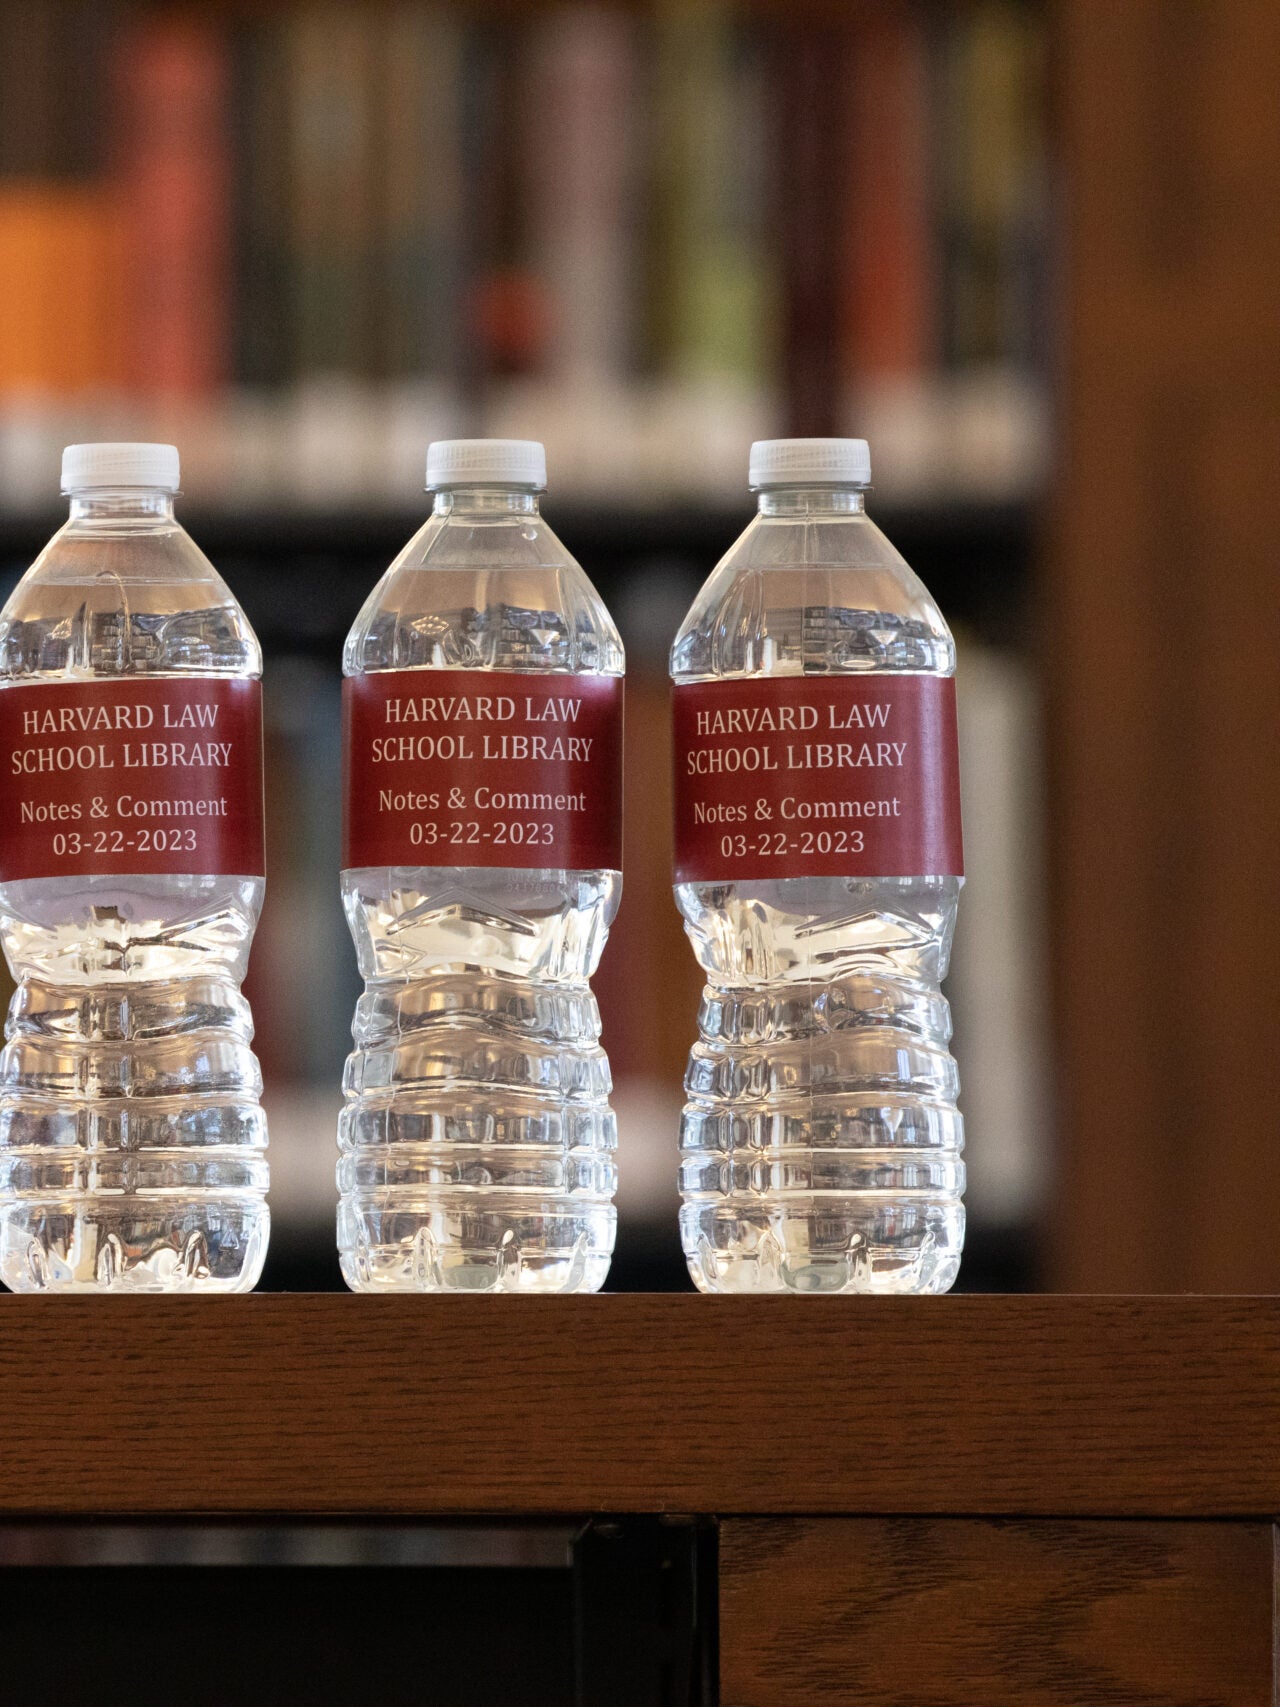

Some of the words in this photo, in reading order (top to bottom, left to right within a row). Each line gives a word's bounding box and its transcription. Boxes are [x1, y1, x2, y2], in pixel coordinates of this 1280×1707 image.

[23, 705, 153, 735] HARVARD
[163, 704, 219, 728] LAW
[385, 697, 515, 723] HARVARD
[525, 697, 581, 722] LAW
[697, 706, 818, 735] HARVARD
[828, 704, 891, 729] LAW
[12, 745, 114, 774] SCHOOL
[123, 743, 233, 767] LIBRARY
[372, 736, 473, 762] SCHOOL
[483, 736, 594, 762] LIBRARY
[687, 746, 778, 775] SCHOOL
[787, 743, 907, 769] LIBRARY
[21, 801, 82, 823] Notes
[90, 797, 109, 818] &
[117, 796, 227, 818] Comment
[379, 789, 439, 811] Notes
[447, 787, 467, 809] &
[475, 787, 586, 812] Comment
[694, 801, 747, 824] Notes
[754, 798, 773, 820] &
[781, 797, 901, 819] Comment
[52, 829, 197, 855] 03-22-2023
[410, 822, 554, 845] 03-22-2023
[720, 831, 865, 857] 03-22-2023
